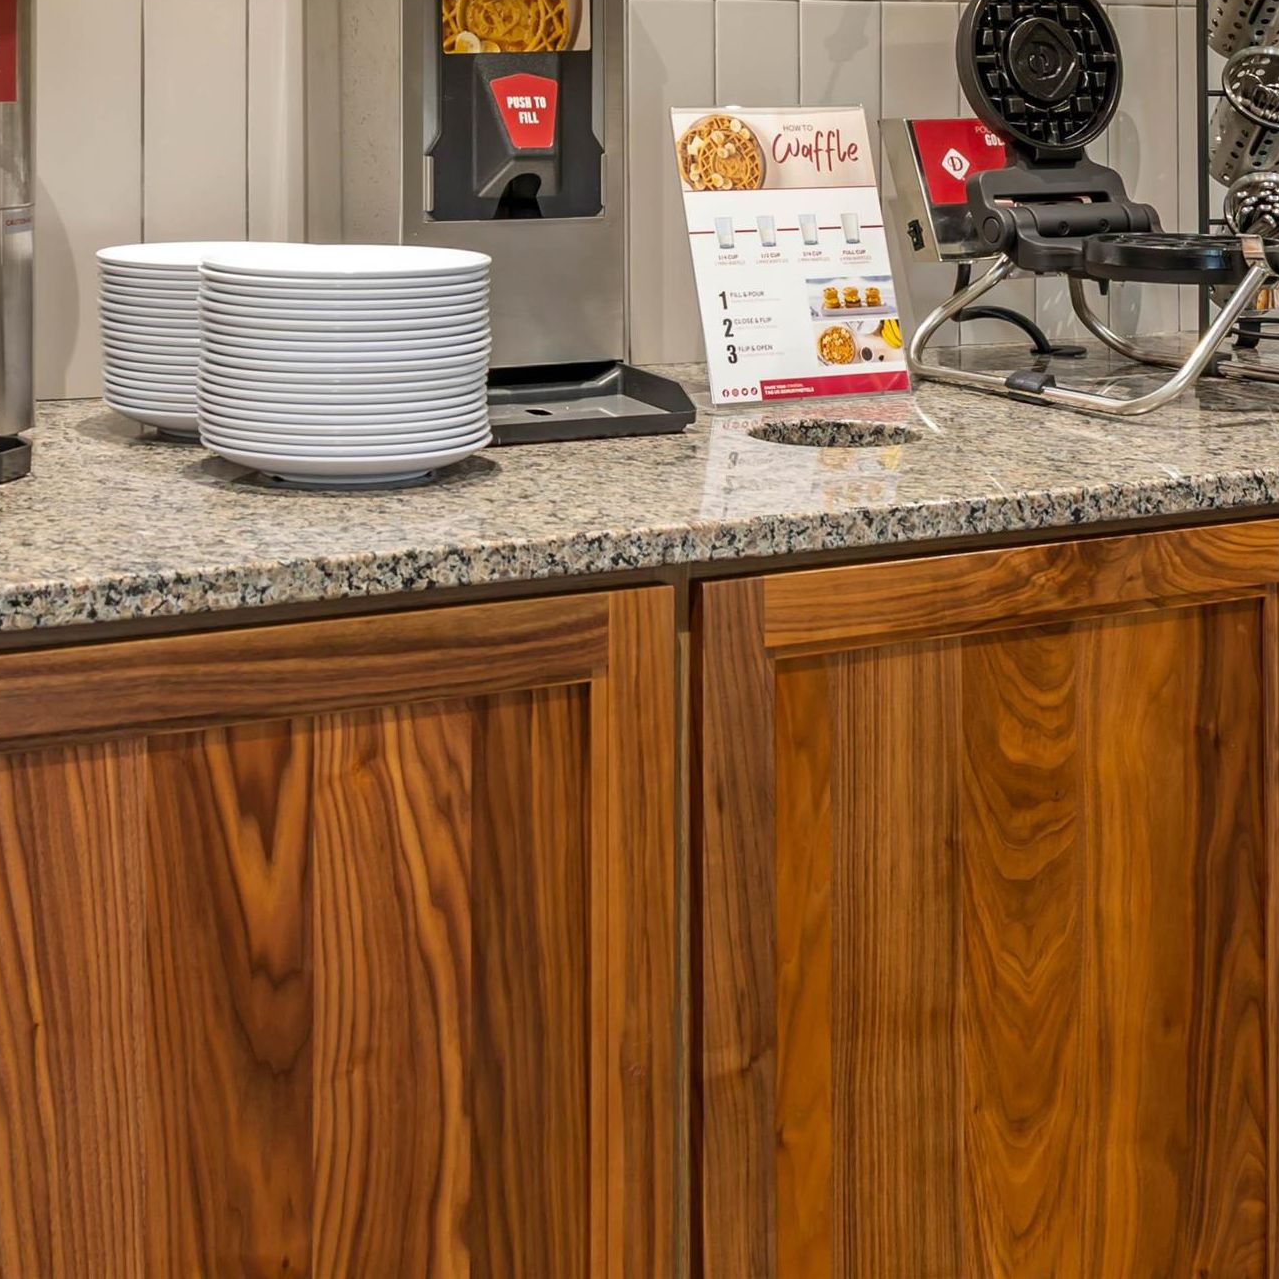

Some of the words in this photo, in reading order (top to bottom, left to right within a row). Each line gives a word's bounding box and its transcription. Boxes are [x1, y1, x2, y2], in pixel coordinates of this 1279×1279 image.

[506, 96, 532, 109] PUSH
[533, 96, 547, 109] TO
[518, 111, 540, 124] FILL
[782, 124, 801, 132] HOW
[801, 124, 814, 132] TO
[718, 290, 728, 310] 1
[722, 318, 734, 338] 2
[734, 317, 754, 325] CLOSE
[726, 344, 738, 364] 3
